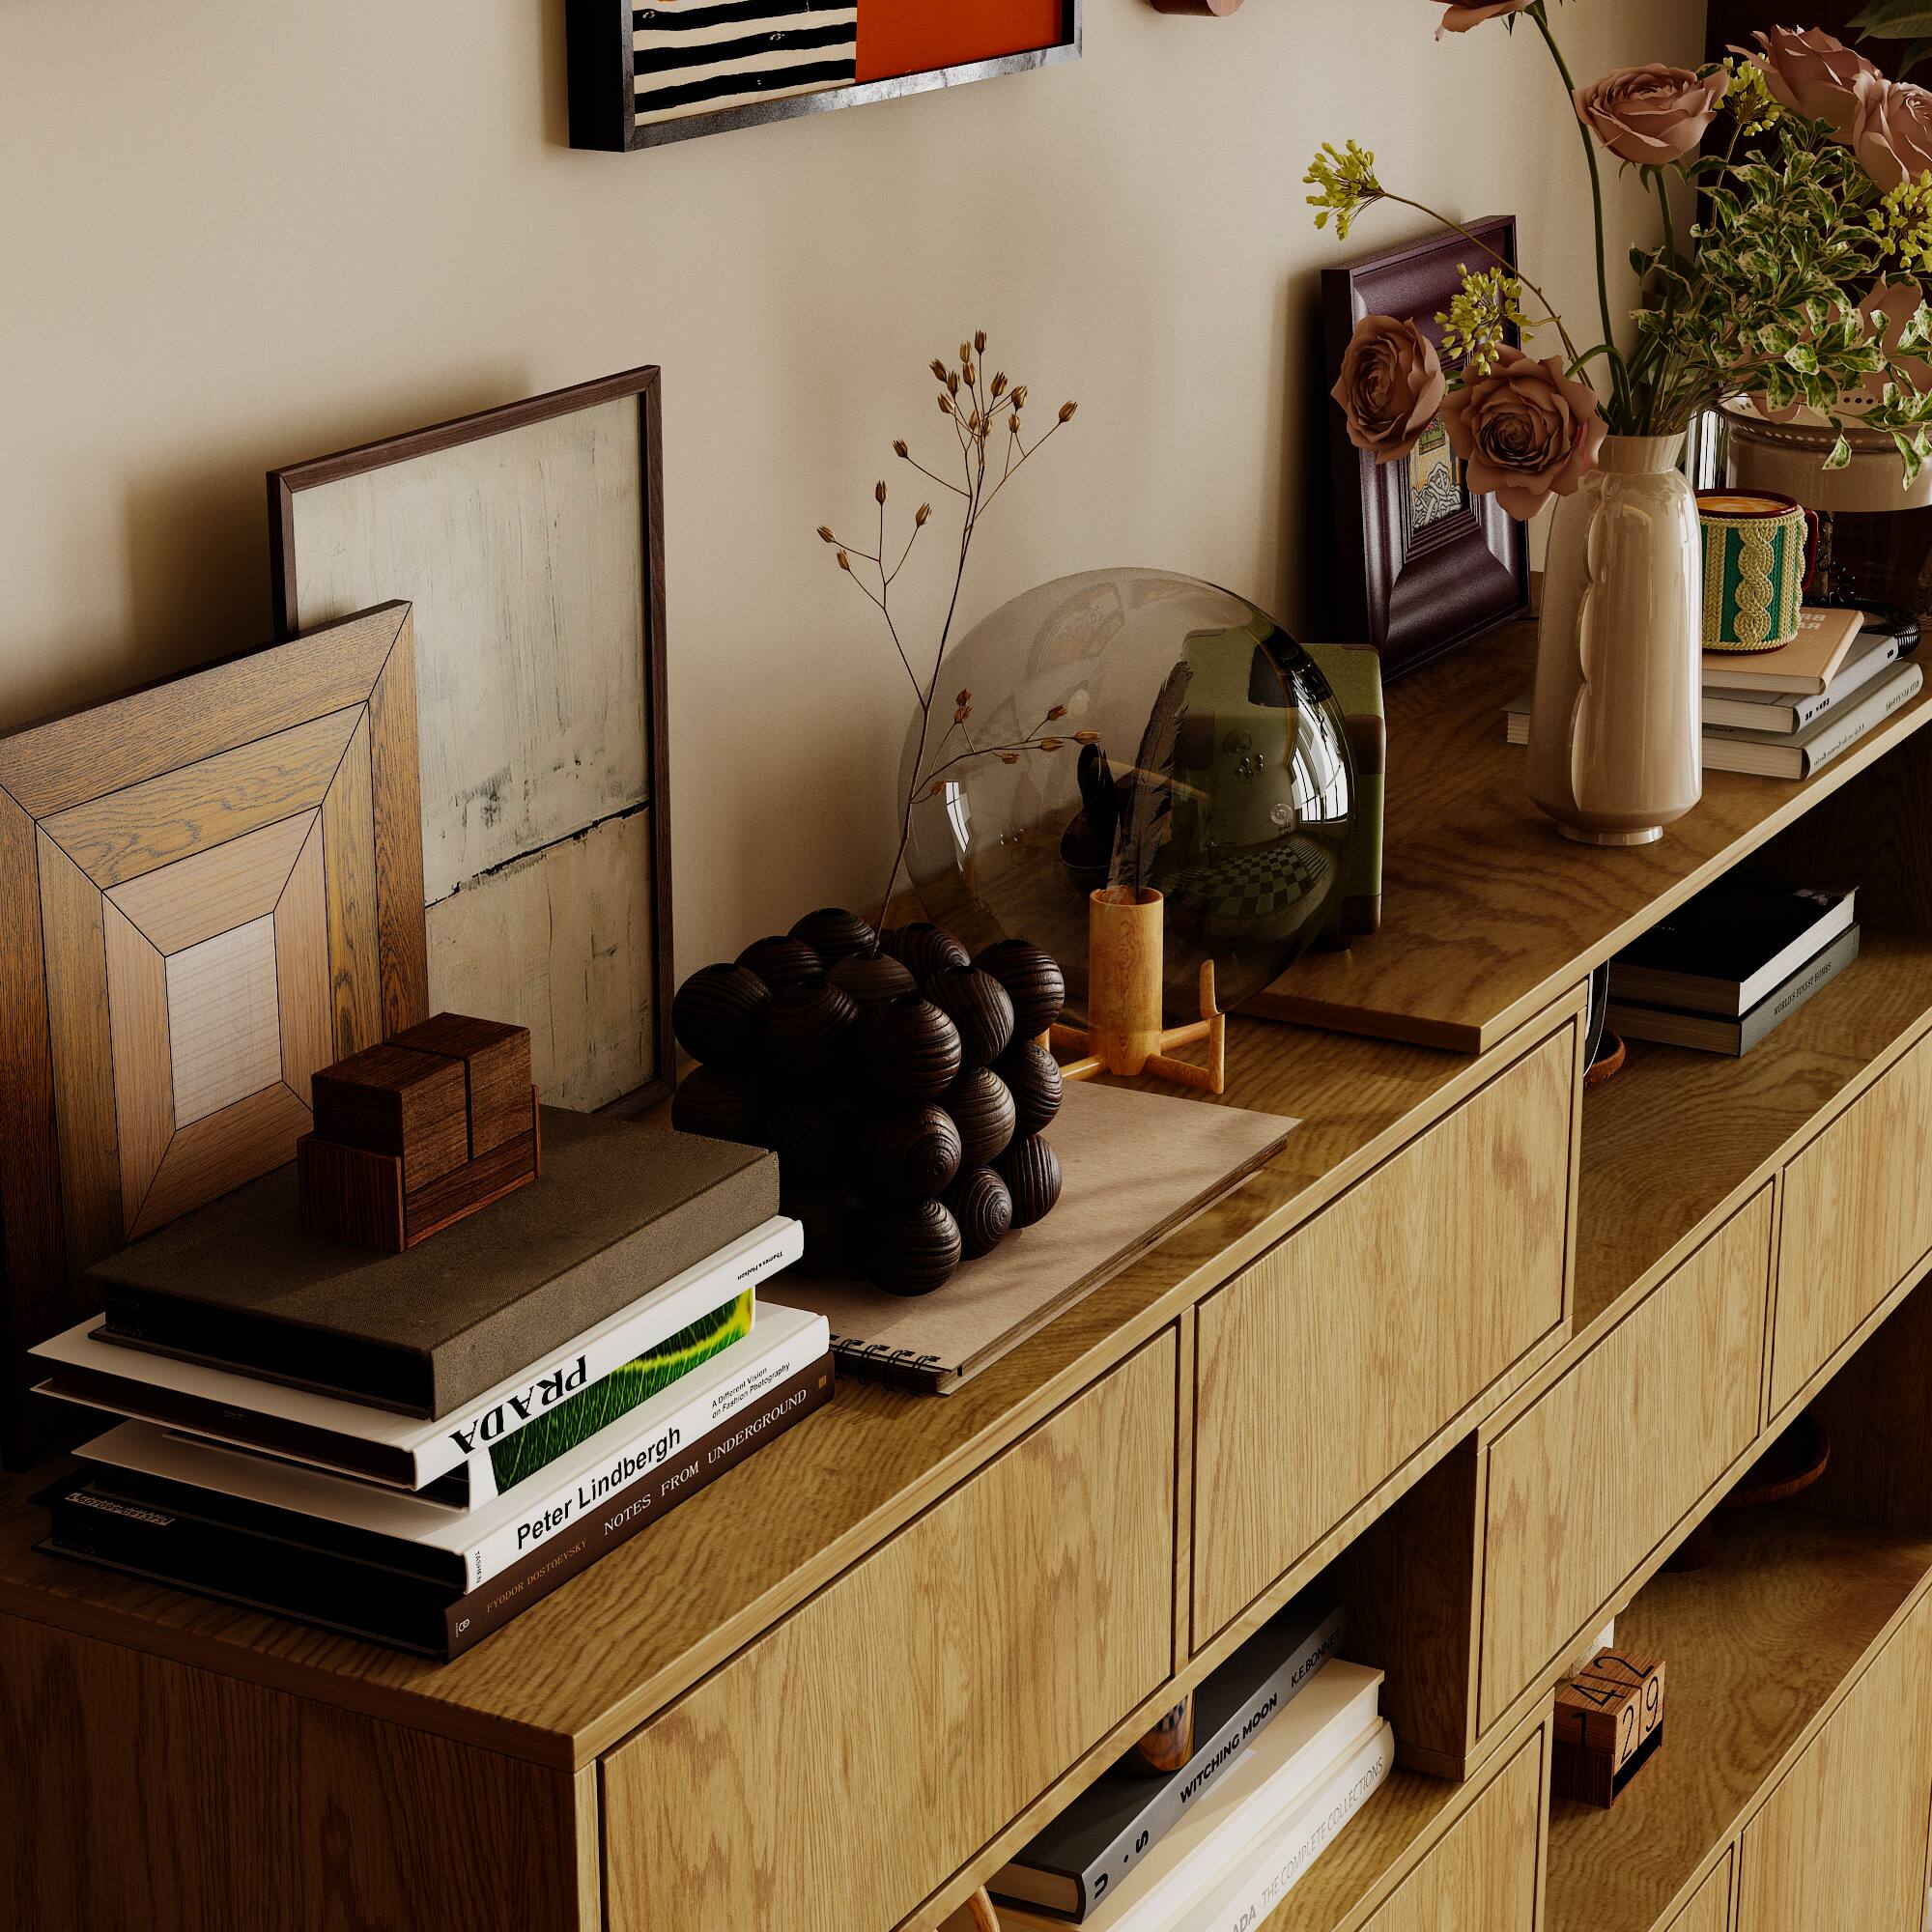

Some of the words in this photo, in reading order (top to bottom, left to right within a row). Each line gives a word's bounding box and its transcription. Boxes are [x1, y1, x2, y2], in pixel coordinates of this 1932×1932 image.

[737, 1264, 759, 1280] Hudson
[449, 1353, 588, 1455] PRADA
[711, 1400, 718, 1408] A
[718, 1380, 747, 1404] Different
[747, 1367, 768, 1384] Vision
[712, 1407, 722, 1419] on
[722, 1391, 749, 1410] Fashion
[750, 1362, 790, 1391] Photography
[516, 1497, 575, 1549] Peter
[577, 1424, 681, 1524] Lindbergh
[603, 1497, 653, 1536] NOTES
[660, 1462, 699, 1509] FROM
[706, 1386, 807, 1471] UNDERGROUND
[485, 1581, 525, 1614] FYODOR
[526, 1537, 587, 1592] DOSTOEVSKY
[1179, 1734, 1240, 1804] WITCHING
[1242, 1692, 1278, 1740] MOON
[1261, 1876, 1279, 1907] THE
[1281, 1821, 1326, 1886] COMPLETE
[1327, 1756, 1383, 1831] COLLECTIONS
